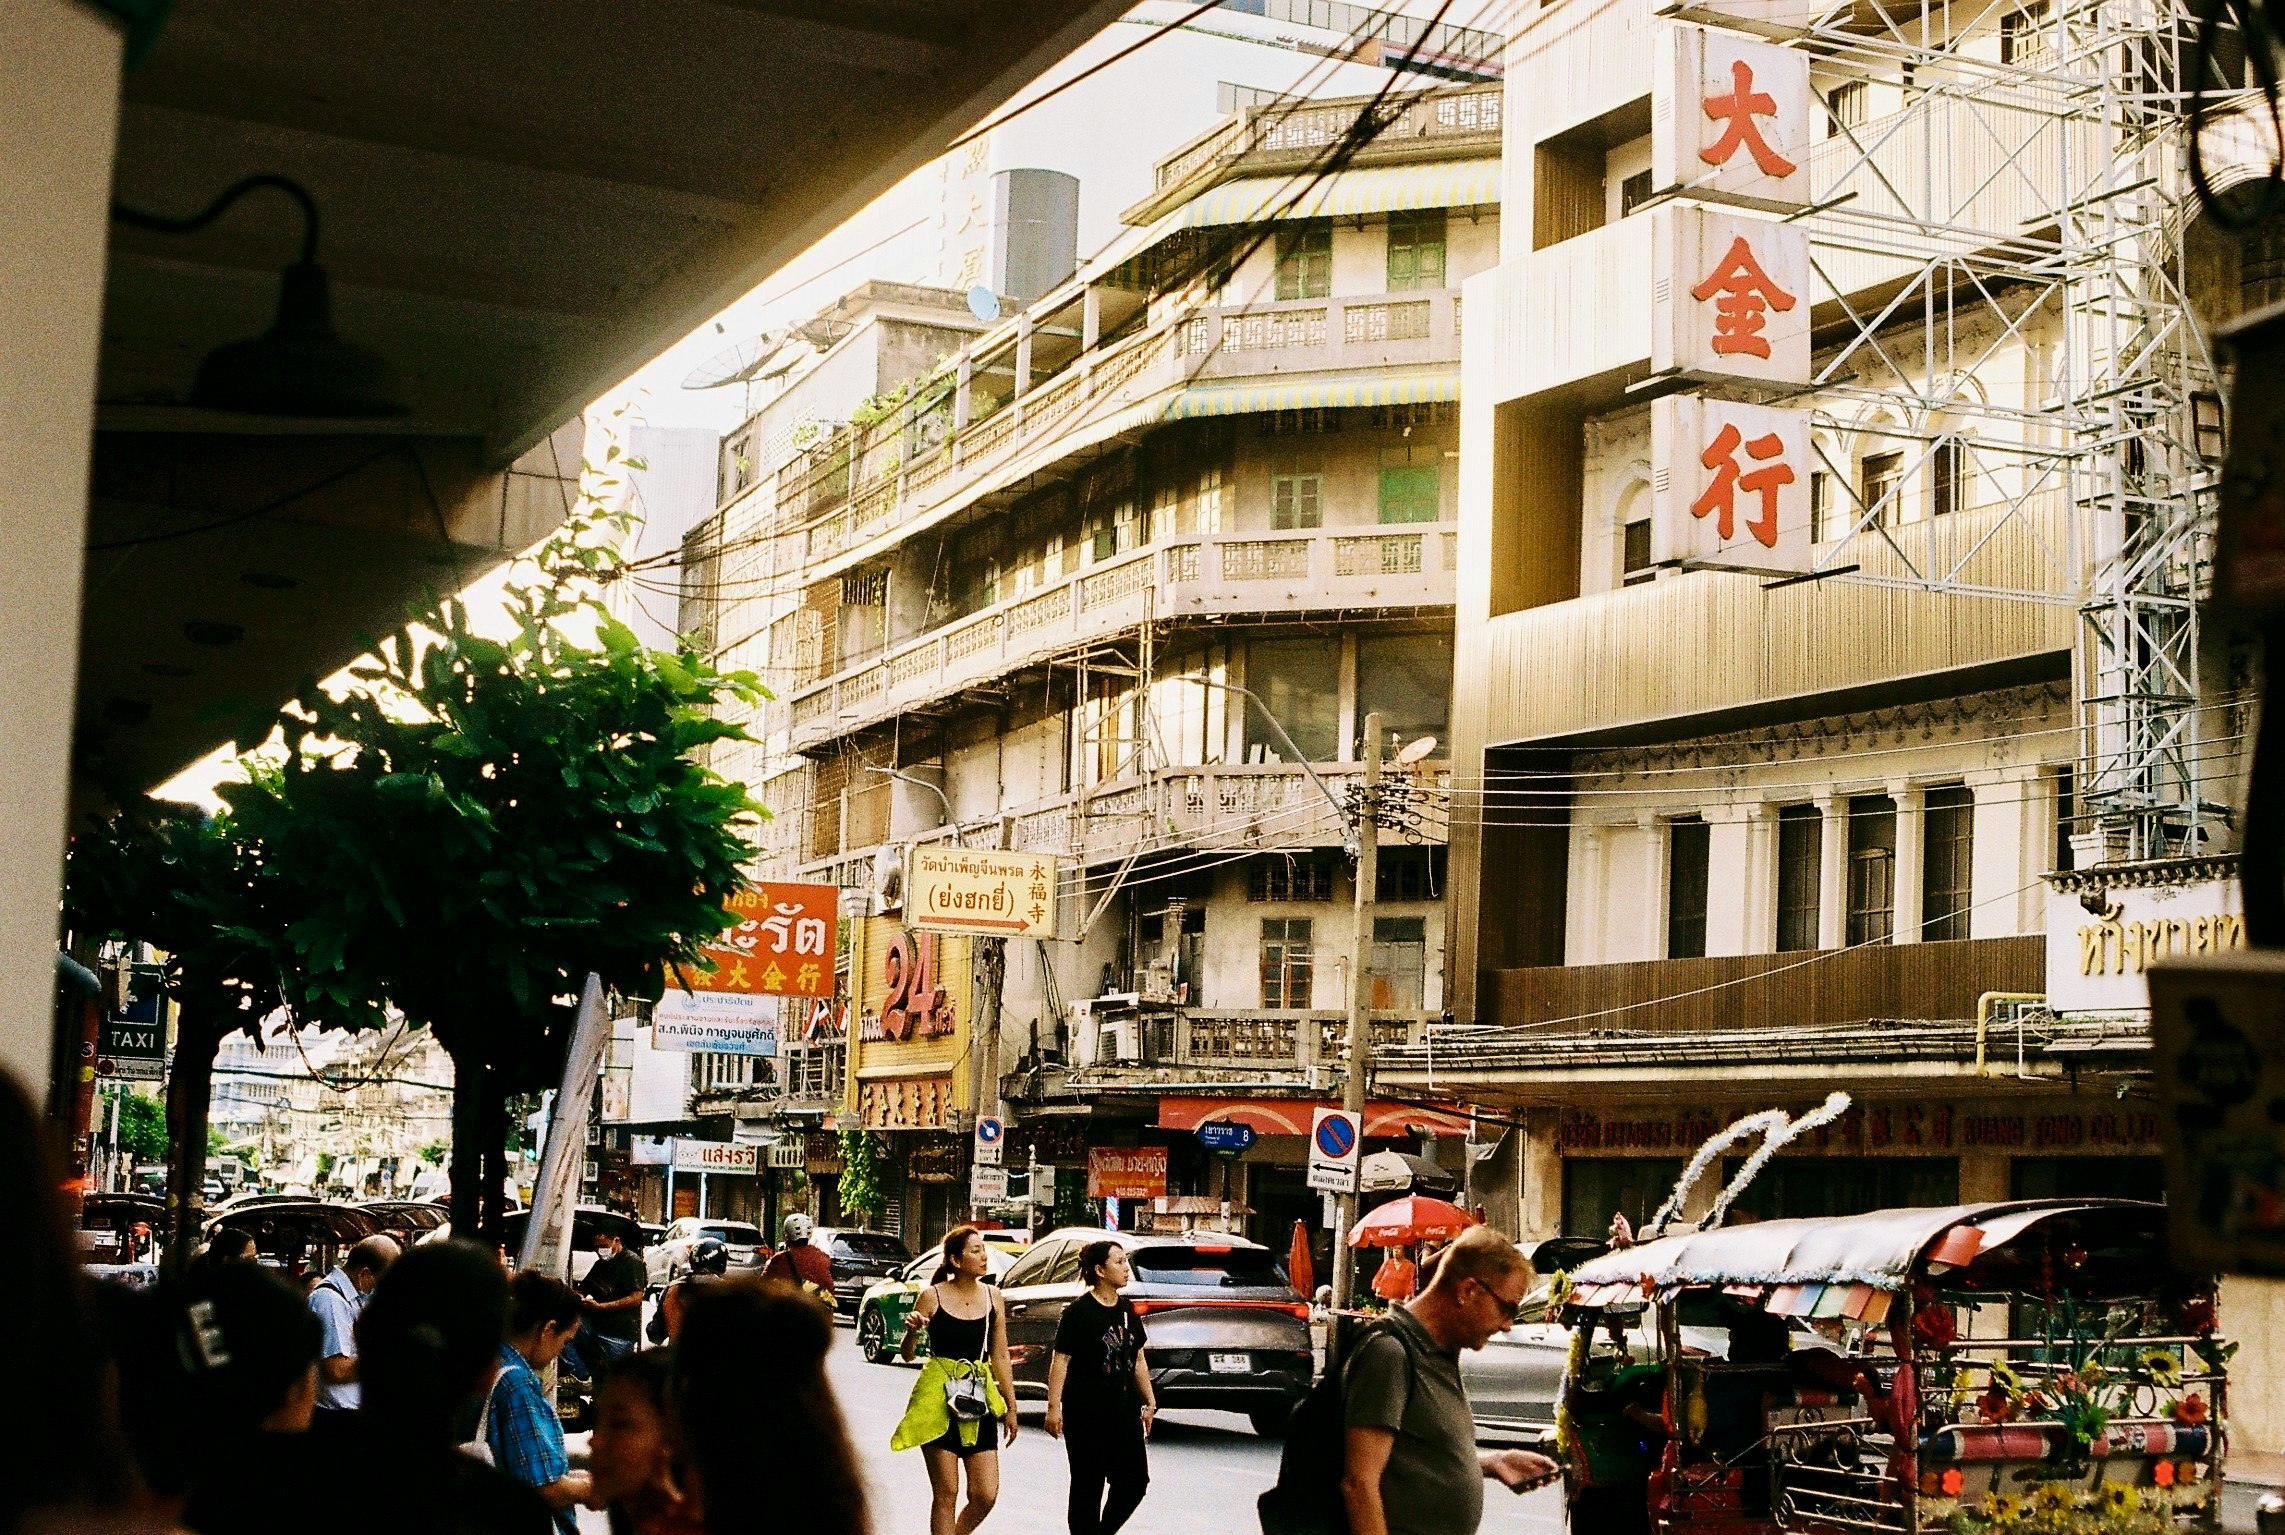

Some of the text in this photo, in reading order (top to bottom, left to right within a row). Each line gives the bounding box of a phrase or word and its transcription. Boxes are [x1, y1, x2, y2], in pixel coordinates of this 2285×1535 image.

[1690, 59, 1796, 548] 大金行
[920, 856, 1024, 879] วัดบำเพ็ญจีนพรต
[929, 882, 1015, 918] (ย่งฮกยี่)
[1028, 861, 1047, 924] 永福寺
[881, 931, 944, 1042] 24
[111, 1031, 155, 1048] TAXI
[1242, 1129, 1250, 1142] 8
